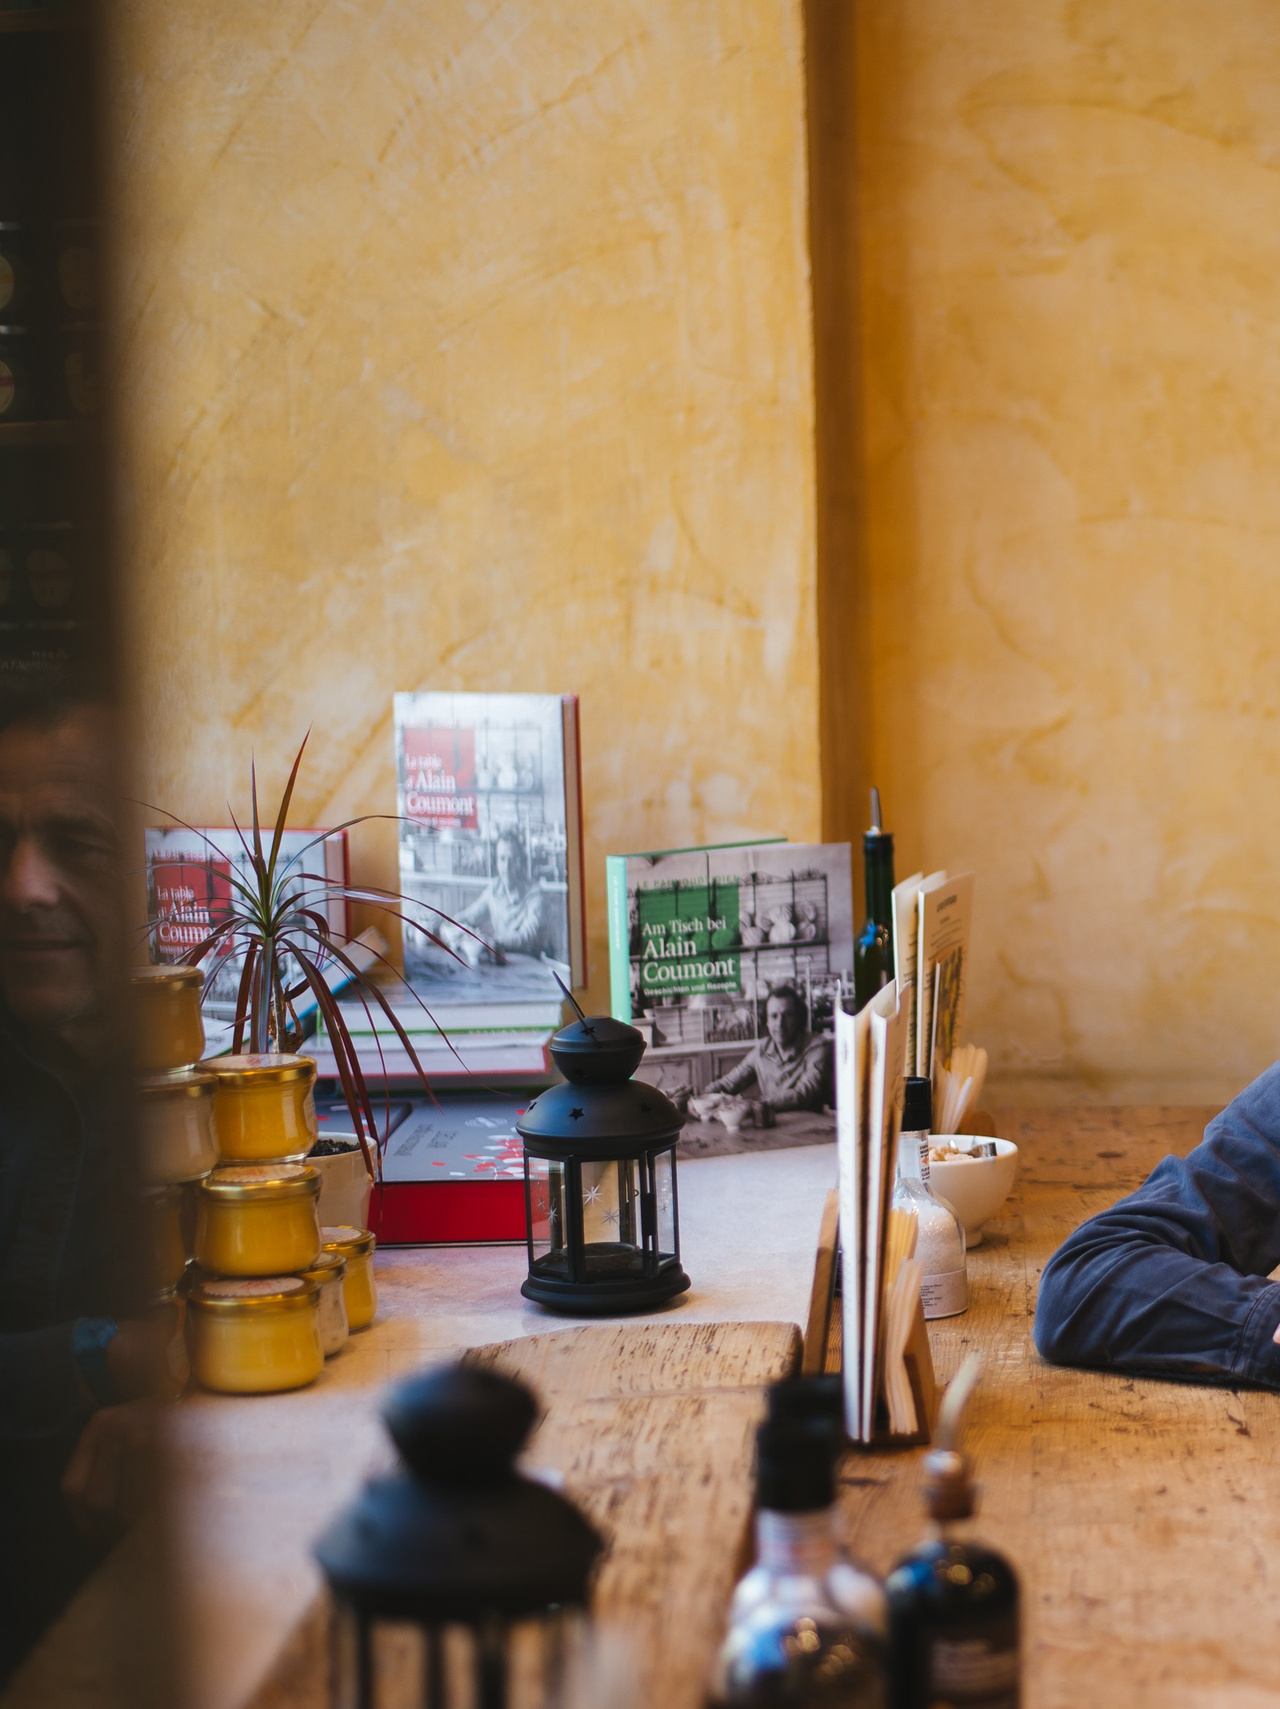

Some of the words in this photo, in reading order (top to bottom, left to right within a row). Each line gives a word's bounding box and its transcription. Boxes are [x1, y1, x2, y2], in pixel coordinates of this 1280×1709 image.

[417, 769, 456, 792] Alain
[406, 791, 475, 817] Coumont
[157, 885, 168, 900] La
[171, 885, 195, 902] table
[169, 901, 210, 923] Alain
[642, 922, 666, 937] Am
[669, 917, 703, 933] Tisch
[706, 915, 727, 931] bei
[643, 937, 697, 959] Alain
[644, 958, 735, 982] Coumont
[691, 983, 706, 992] und
[706, 981, 737, 991] Rezepte
